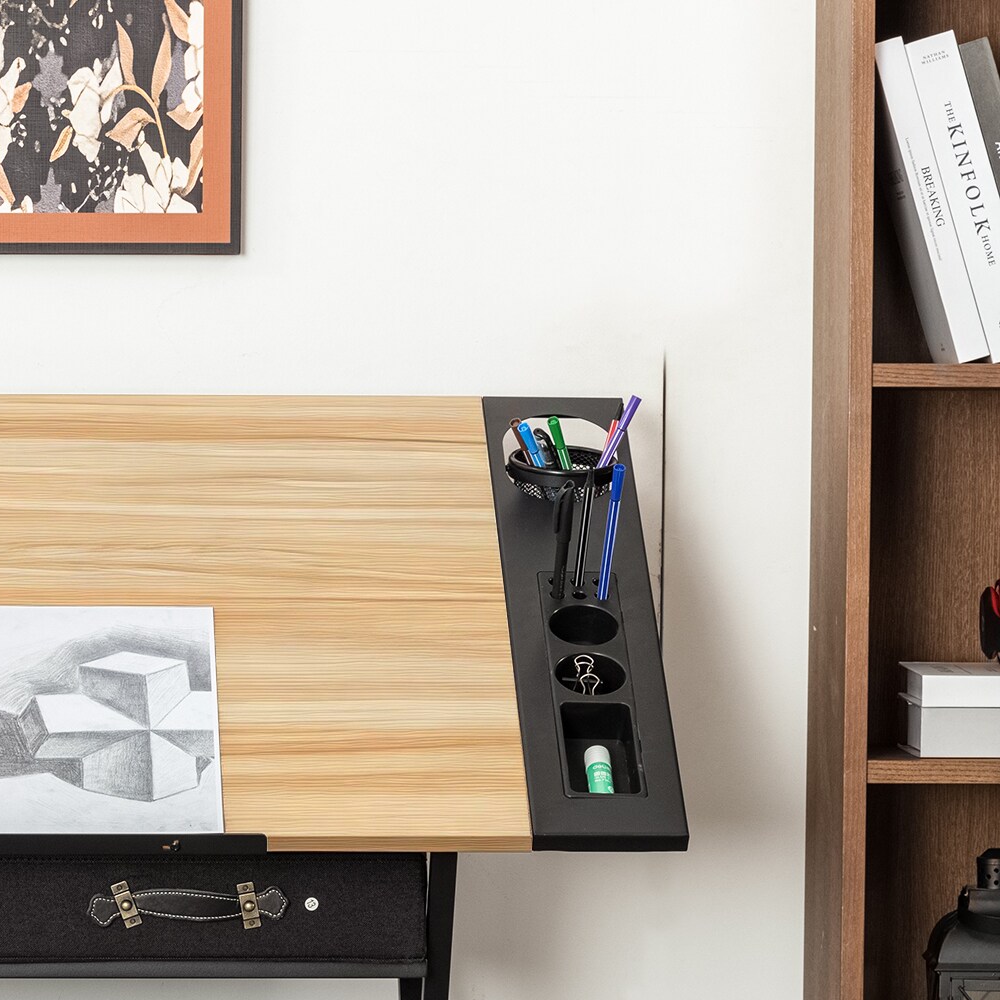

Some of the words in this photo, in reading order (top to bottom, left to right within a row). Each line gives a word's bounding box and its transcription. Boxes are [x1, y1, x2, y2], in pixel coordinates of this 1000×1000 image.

[944, 101, 956, 122] THE
[921, 166, 946, 227] BREAKING
[948, 123, 991, 236] KINFOLK
[981, 235, 997, 266] HOME
